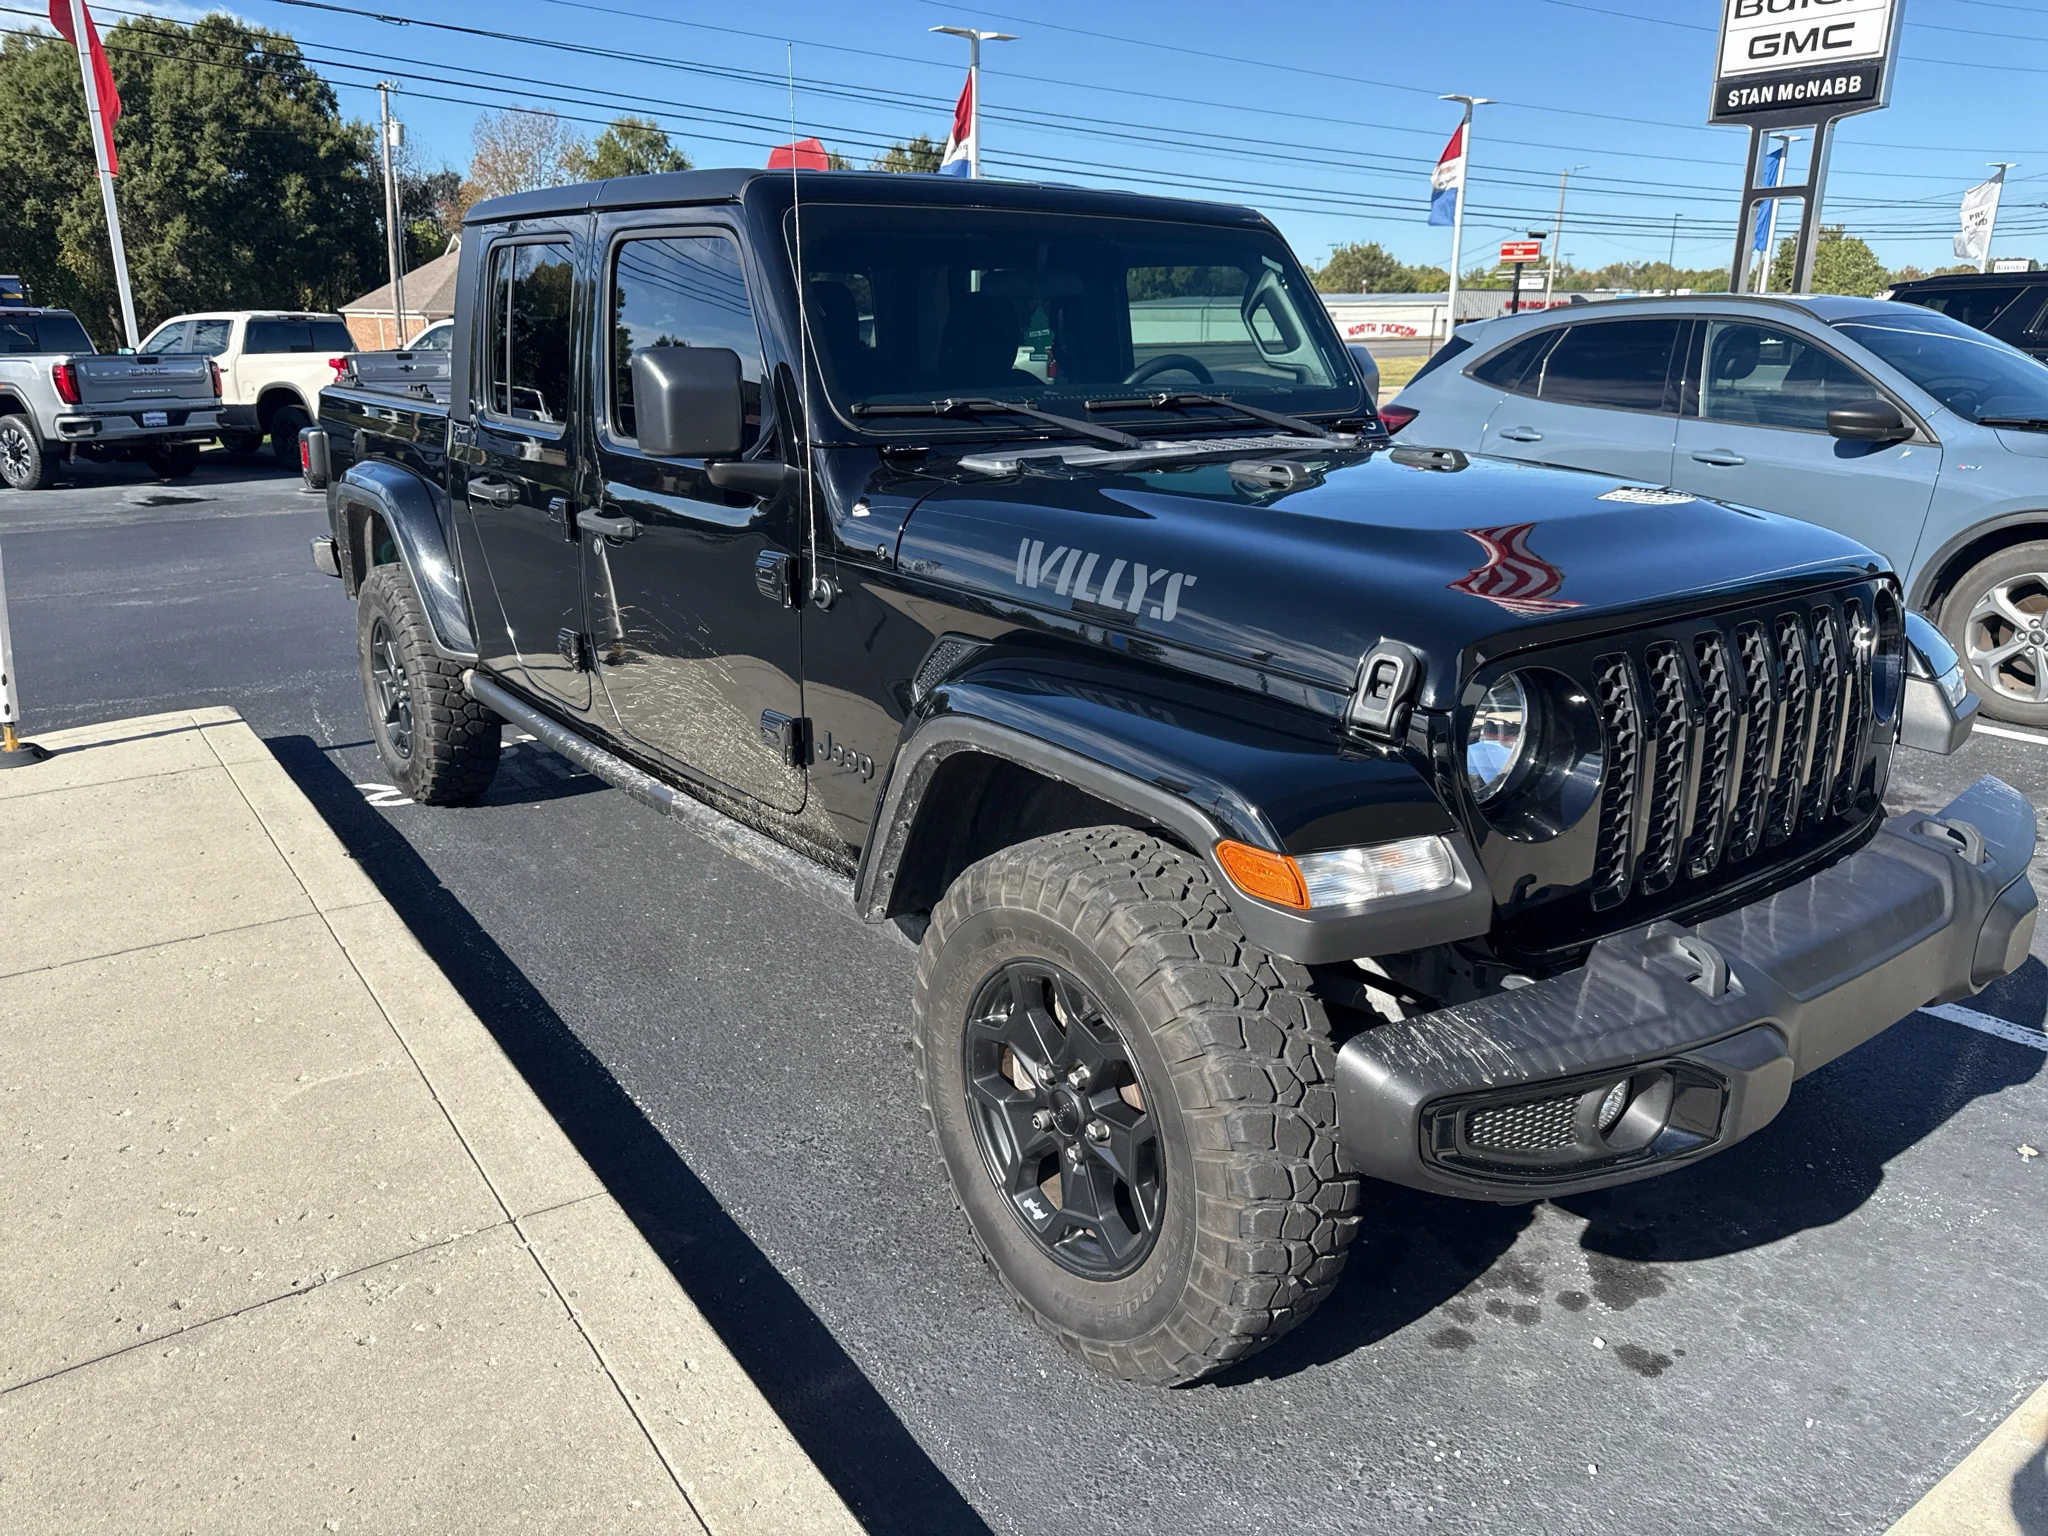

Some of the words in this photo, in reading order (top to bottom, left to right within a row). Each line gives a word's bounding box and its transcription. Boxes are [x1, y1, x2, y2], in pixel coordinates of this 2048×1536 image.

[1748, 22, 1856, 60] GMC
[1727, 85, 1774, 107] STAN
[1777, 75, 1862, 101] McNABB
[1348, 323, 1376, 337] NORTH
[1380, 323, 1418, 337] JACKSON
[129, 367, 170, 377] GMC
[1015, 537, 1198, 622] WILLYS
[816, 730, 875, 784] Jeep
